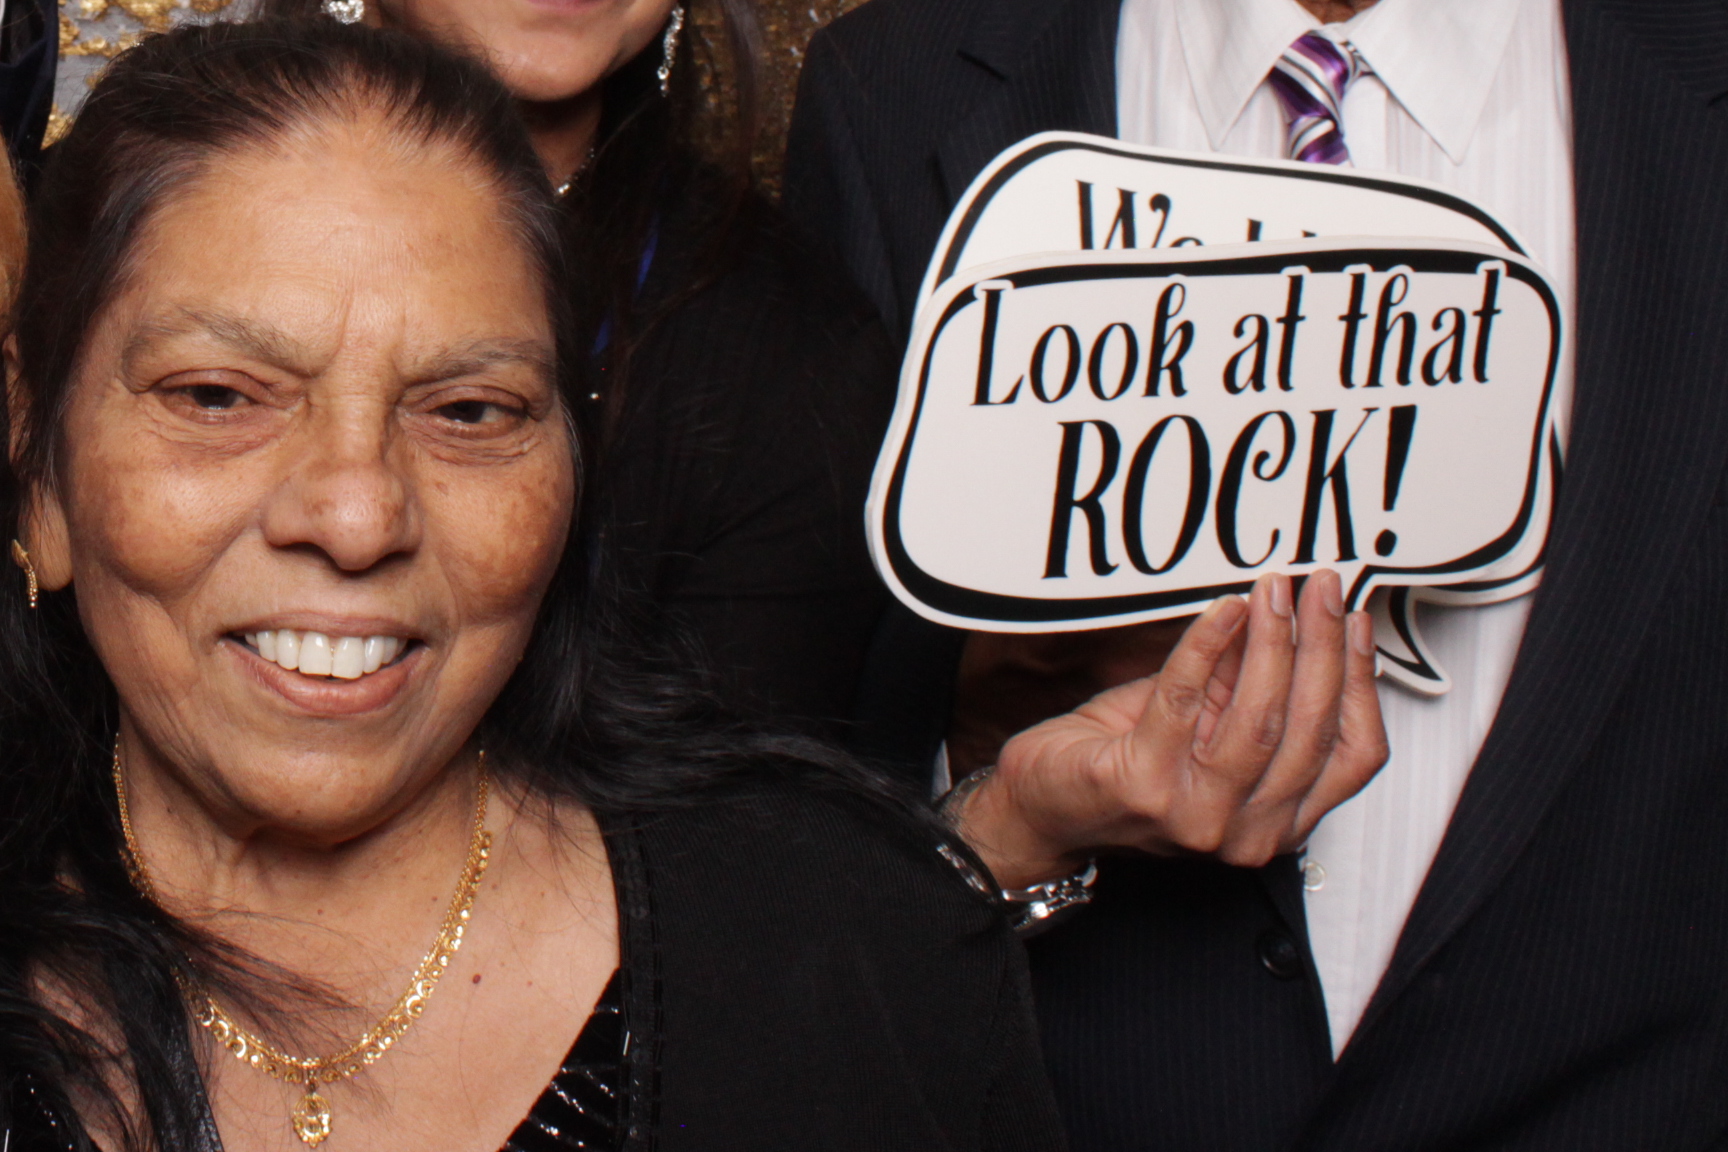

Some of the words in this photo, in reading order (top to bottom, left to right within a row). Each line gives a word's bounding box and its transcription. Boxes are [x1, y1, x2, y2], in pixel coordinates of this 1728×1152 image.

[969, 281, 1195, 406] Look
[1222, 273, 1307, 395] at
[1337, 268, 1503, 389] that
[1040, 403, 1418, 579] ROCK!
